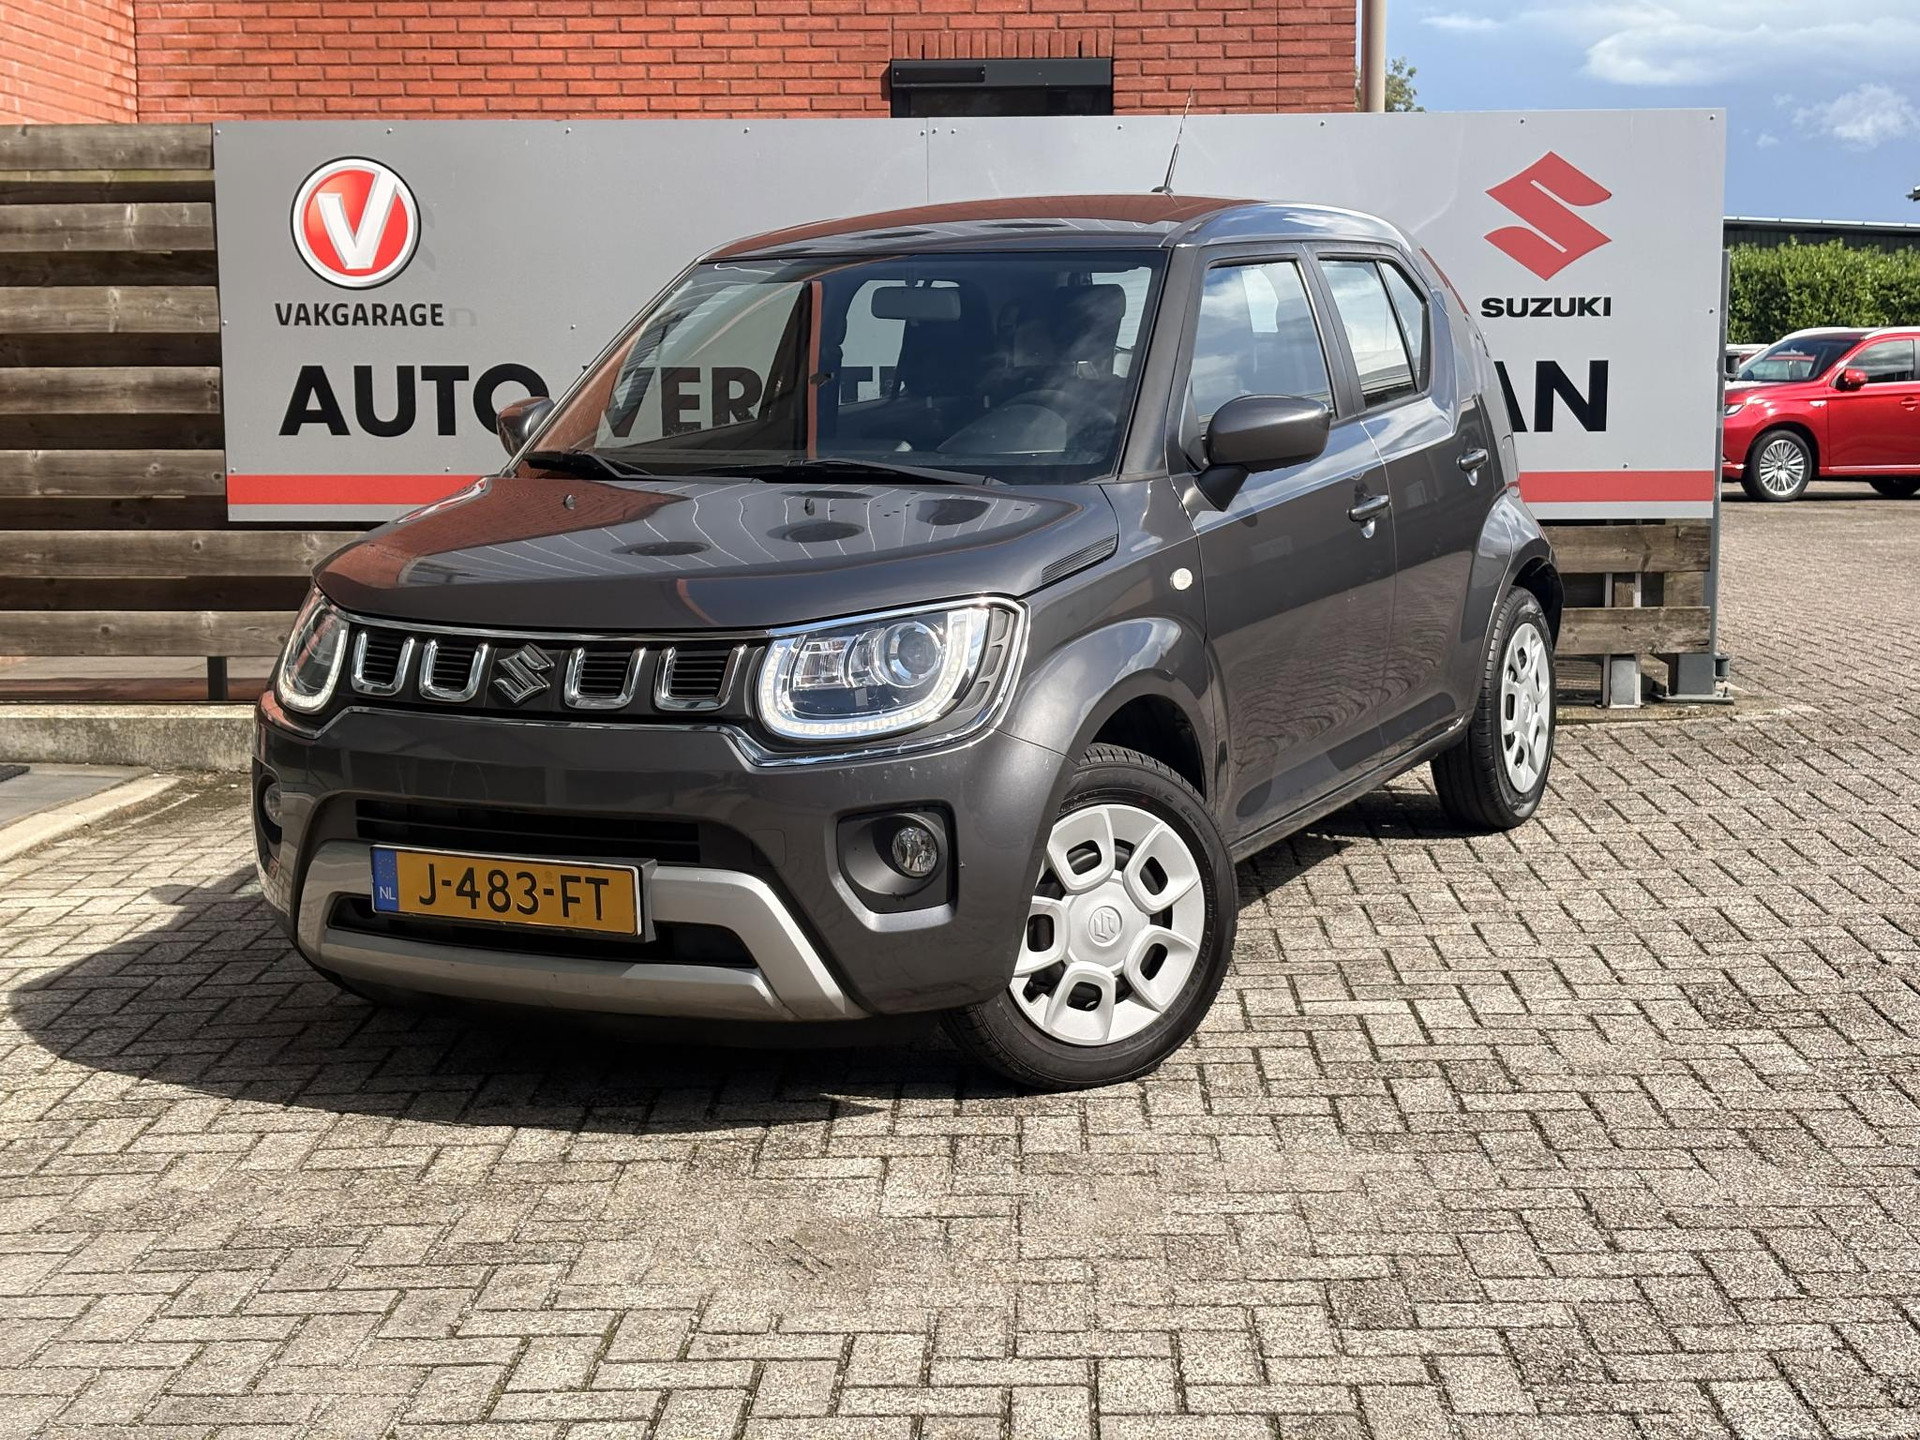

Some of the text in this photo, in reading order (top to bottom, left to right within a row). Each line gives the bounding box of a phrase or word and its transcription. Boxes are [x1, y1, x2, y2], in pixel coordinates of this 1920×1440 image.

[275, 303, 444, 327] VAKGARAGE
[1480, 297, 1611, 318] SUZUKI
[279, 362, 550, 437] AUTO
[379, 886, 397, 901] NL
[419, 863, 609, 921] J-483-FT
